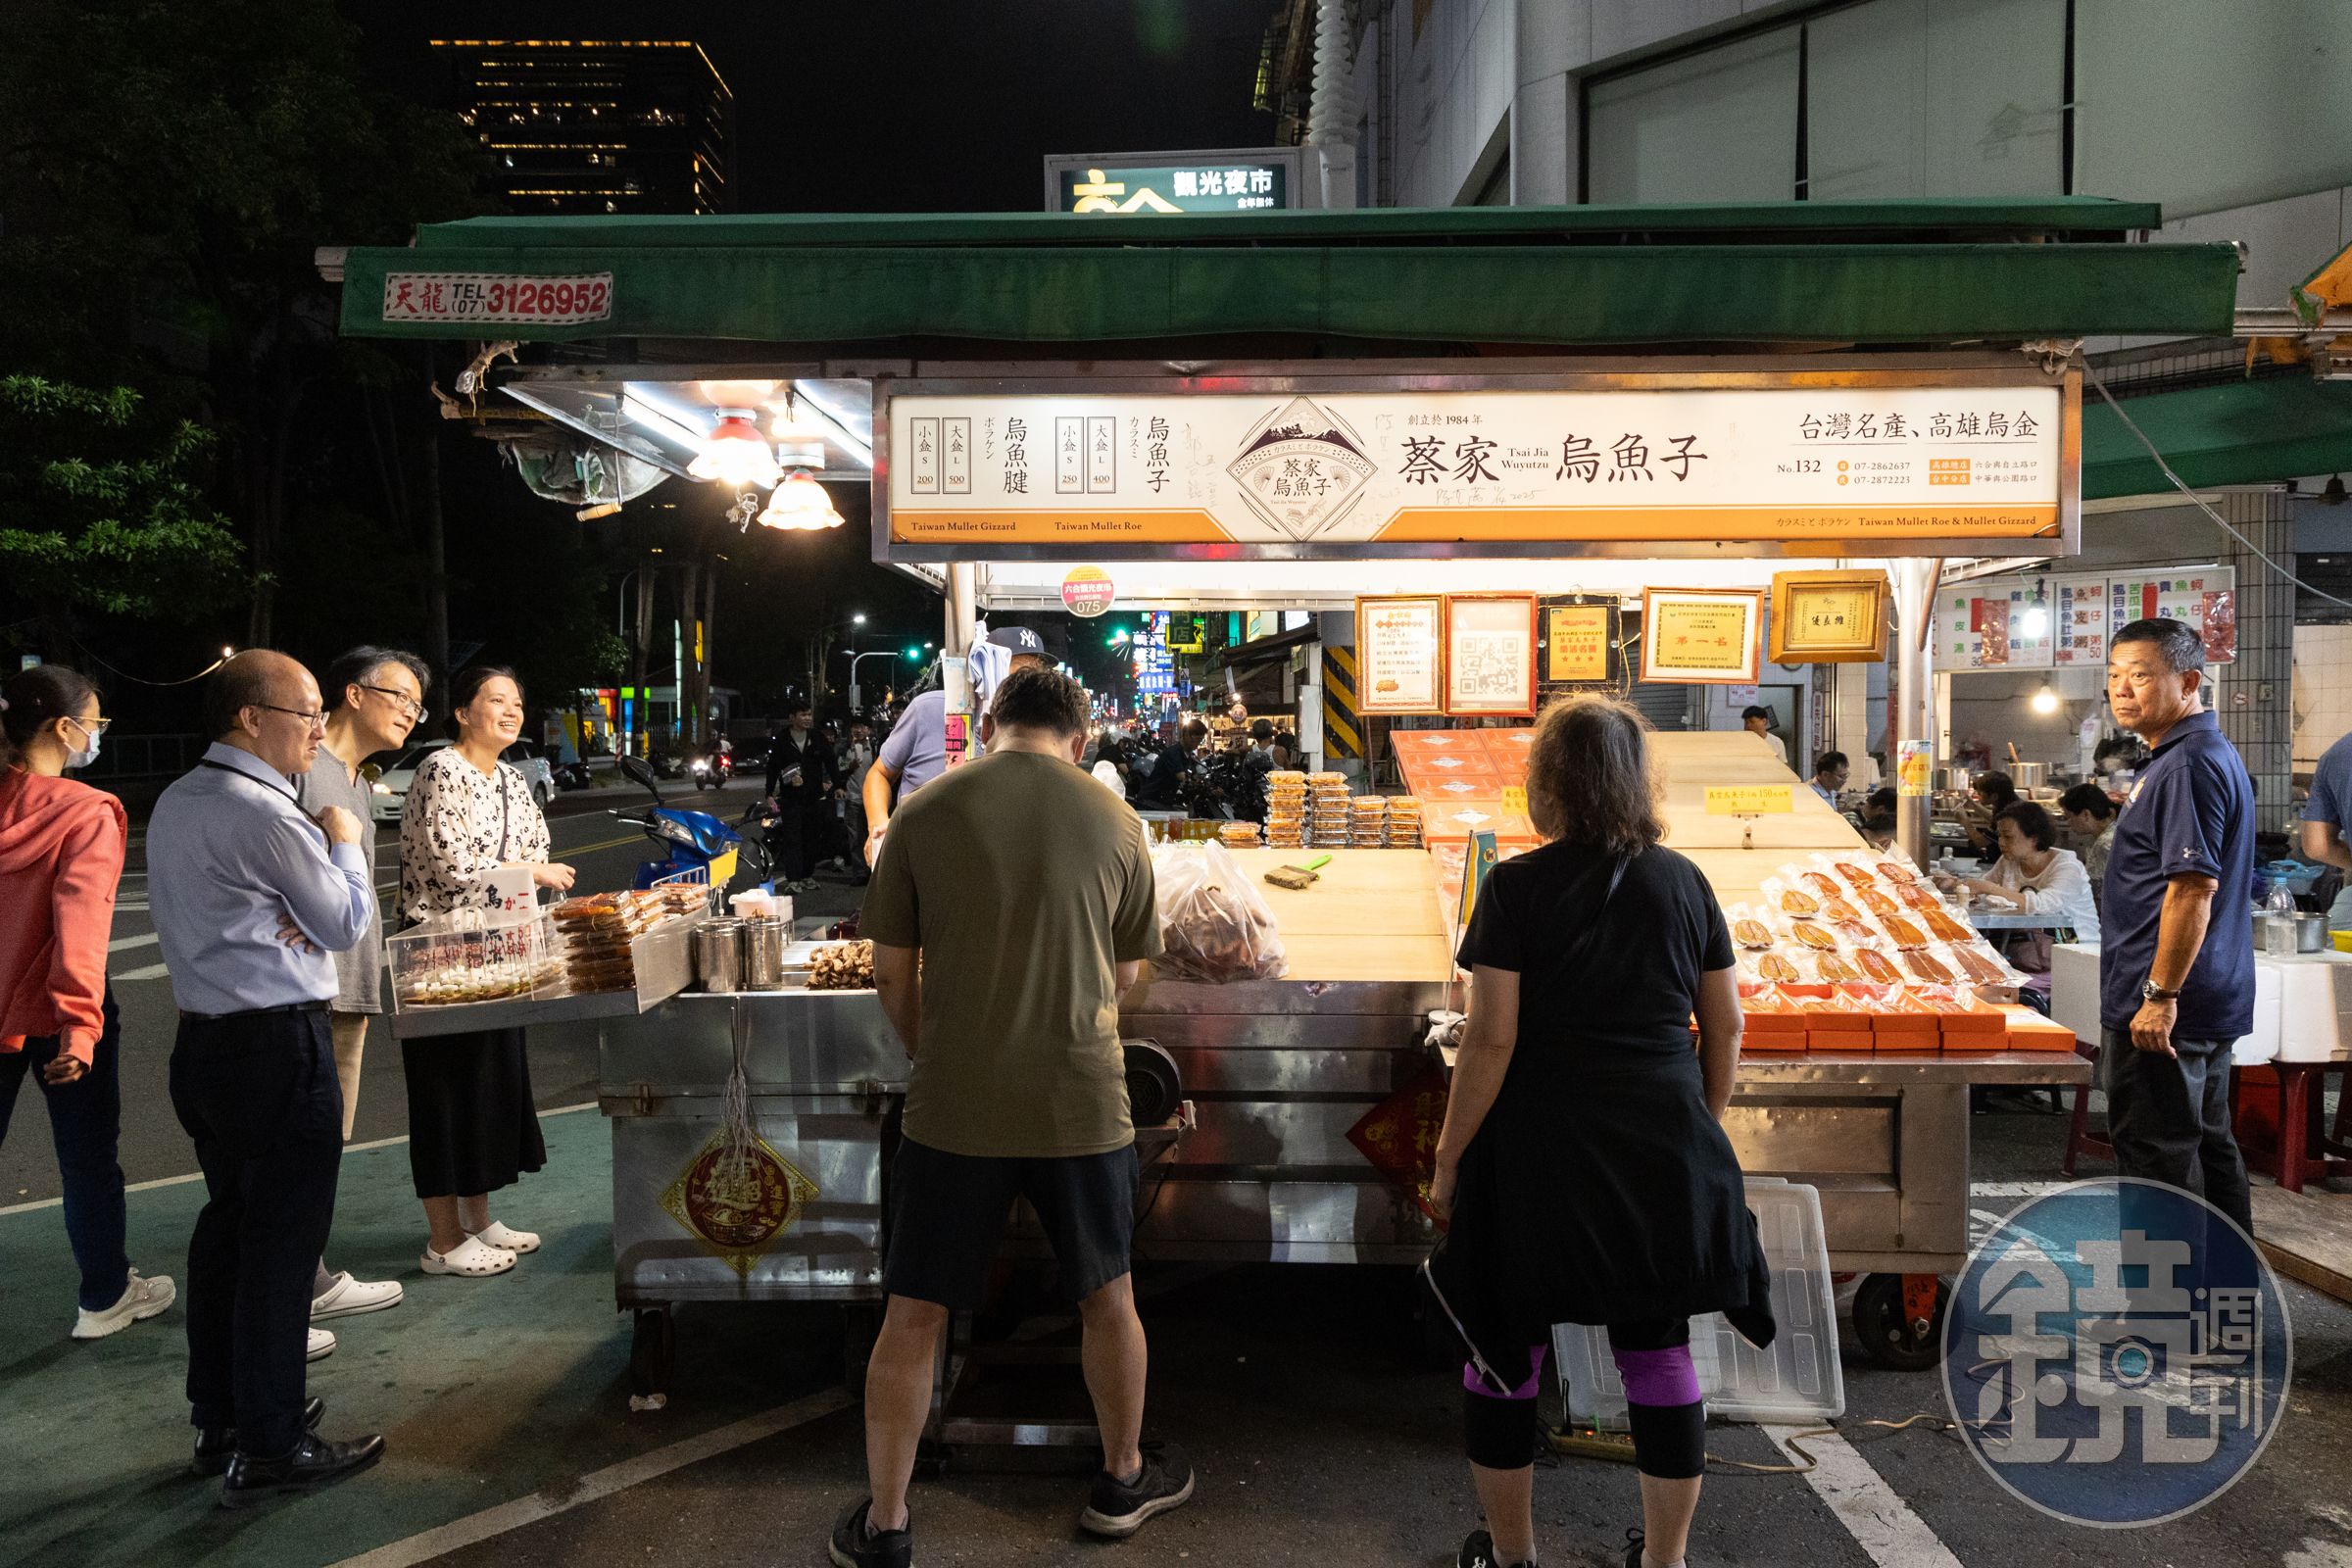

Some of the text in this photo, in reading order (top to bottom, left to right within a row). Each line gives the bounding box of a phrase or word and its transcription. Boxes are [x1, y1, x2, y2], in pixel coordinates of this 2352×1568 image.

[1173, 169, 1273, 197] 觀光夜市
[393, 281, 447, 314] 天龍
[452, 283, 486, 300] TEL
[487, 282, 607, 316] 3126952
[452, 299, 485, 315] (07)
[1407, 415, 1483, 426] 創立於 1984 年
[918, 425, 932, 453] 小盒
[951, 425, 963, 453] 大盒
[984, 416, 996, 460] ボラケン
[1063, 425, 1077, 452] 小盒
[1096, 424, 1108, 452] 大盒
[1129, 416, 1139, 459] カラスミ
[1003, 416, 1029, 494] 烏魚腱
[1147, 416, 1170, 493] 烏魚子
[1397, 435, 1500, 485] 蔡家
[1555, 433, 1708, 484] 烏魚子
[1507, 448, 1548, 458] Tsai Jia
[1283, 459, 1321, 477] 蔡家
[1501, 460, 1549, 472] Wuyutzu
[1854, 462, 1911, 470] 07-2862637
[917, 475, 933, 484] 200
[949, 475, 964, 484] 500
[1093, 474, 1109, 483] 400
[1854, 475, 1911, 484] 07-2872223
[1273, 478, 1332, 497] 烏魚子
[911, 521, 1016, 531] Taiwan Mullet Gizzard
[1054, 521, 1142, 531] Taiwan Mullet Roe
[1859, 517, 1893, 526] Taiwan
[1896, 516, 1929, 526] Mullet
[1932, 516, 1950, 526] Roe
[1952, 516, 1961, 525] &
[1963, 516, 1996, 525] Mullet
[1998, 515, 2036, 525] Gizzard
[1064, 582, 1112, 594] 六合觀光夜市
[1077, 601, 1101, 612] 075
[2061, 587, 2073, 648] 虱目魚肚粥
[1019, 629, 1037, 648] NY
[2088, 647, 2101, 659] 50
